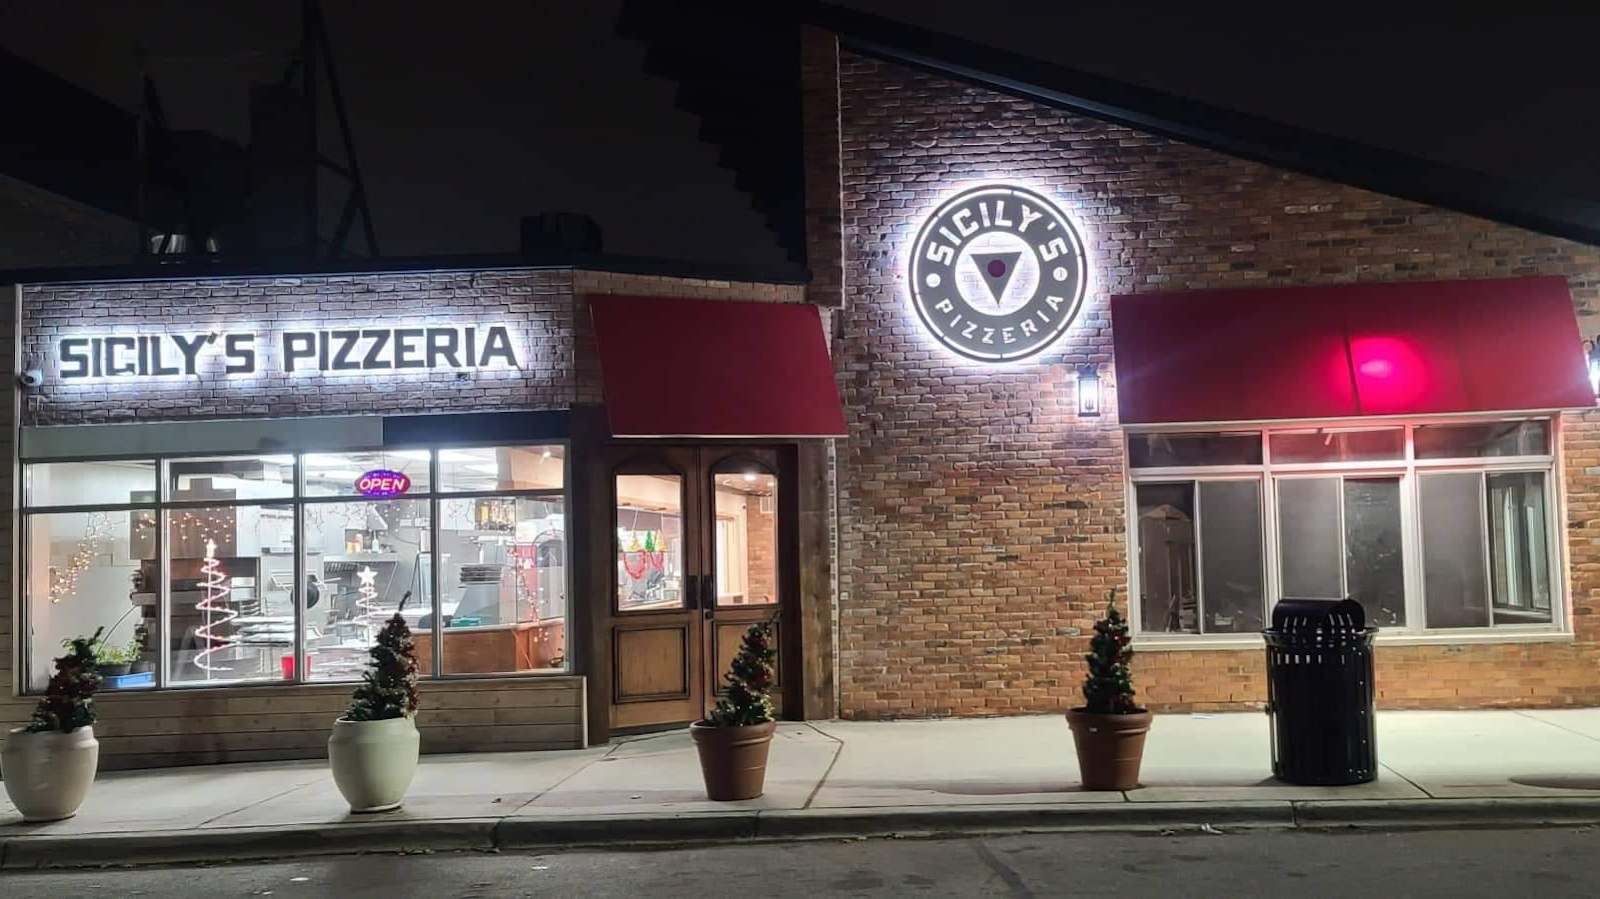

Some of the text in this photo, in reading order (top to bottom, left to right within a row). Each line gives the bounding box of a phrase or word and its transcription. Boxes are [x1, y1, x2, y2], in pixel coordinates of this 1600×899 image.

[926, 200, 1068, 266] SICILY'S
[935, 295, 1064, 344] PIZZERIA
[60, 326, 521, 378] SICILY'S PIZZERIA
[359, 478, 405, 491] OPEN
